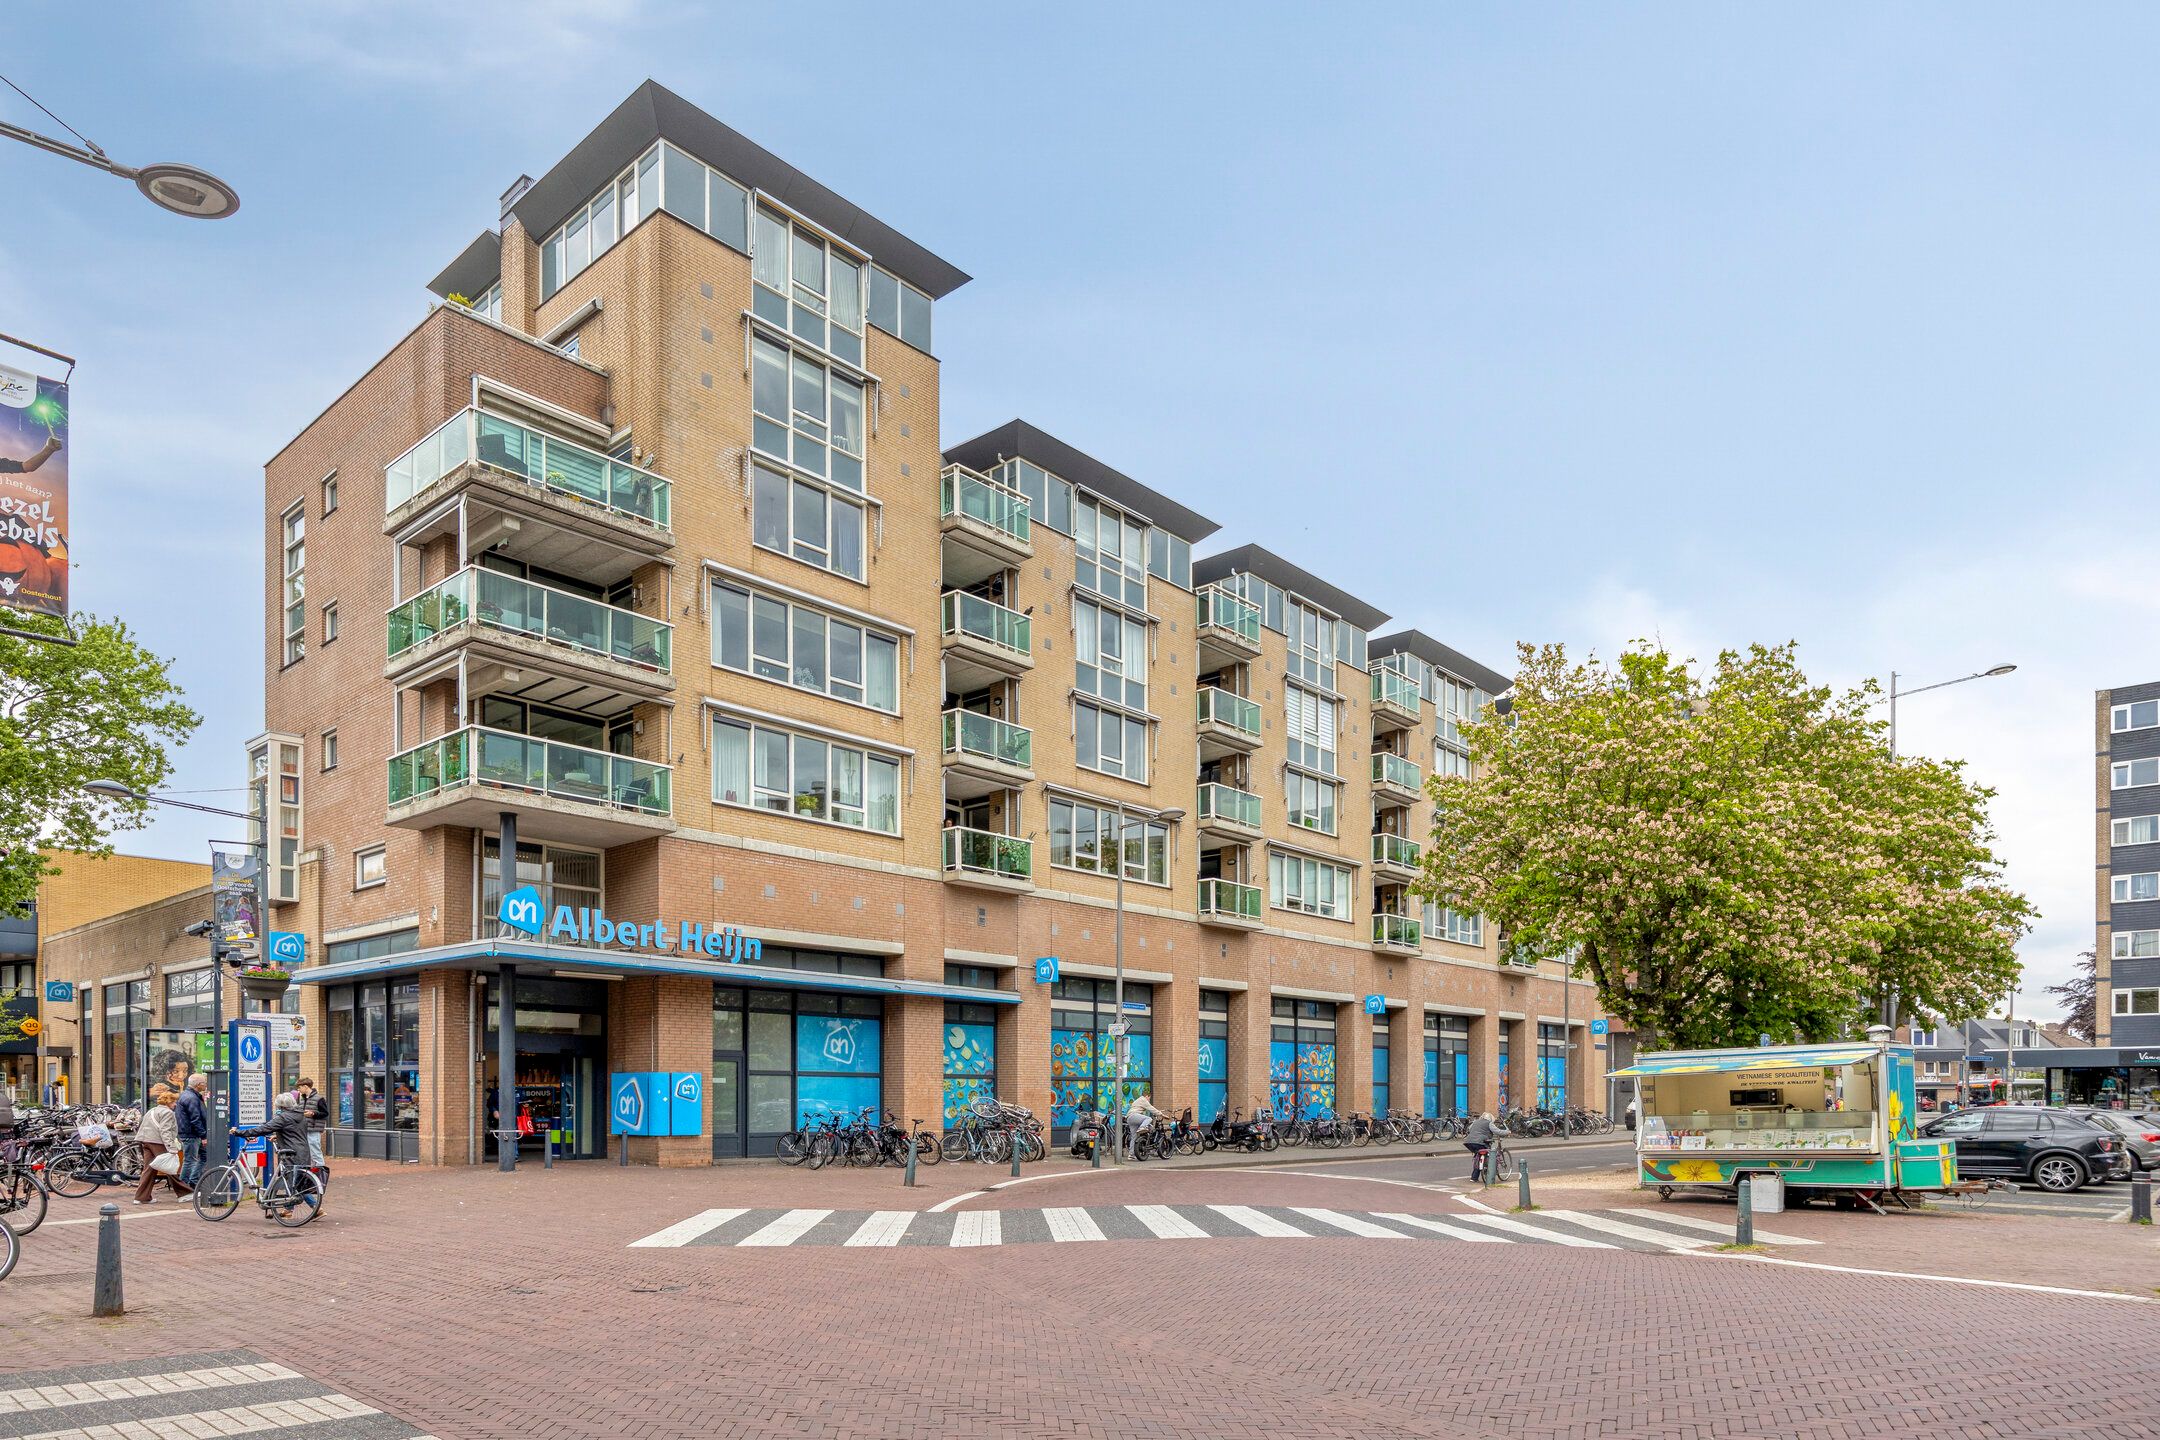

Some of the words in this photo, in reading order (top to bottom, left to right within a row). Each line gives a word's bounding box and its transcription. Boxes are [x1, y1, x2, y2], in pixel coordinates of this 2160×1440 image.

[6, 476, 24, 489] het
[25, 484, 52, 499] aan?
[22, 588, 62, 602] Oosterhout
[550, 904, 668, 949] Albert
[679, 920, 762, 964] Heijn
